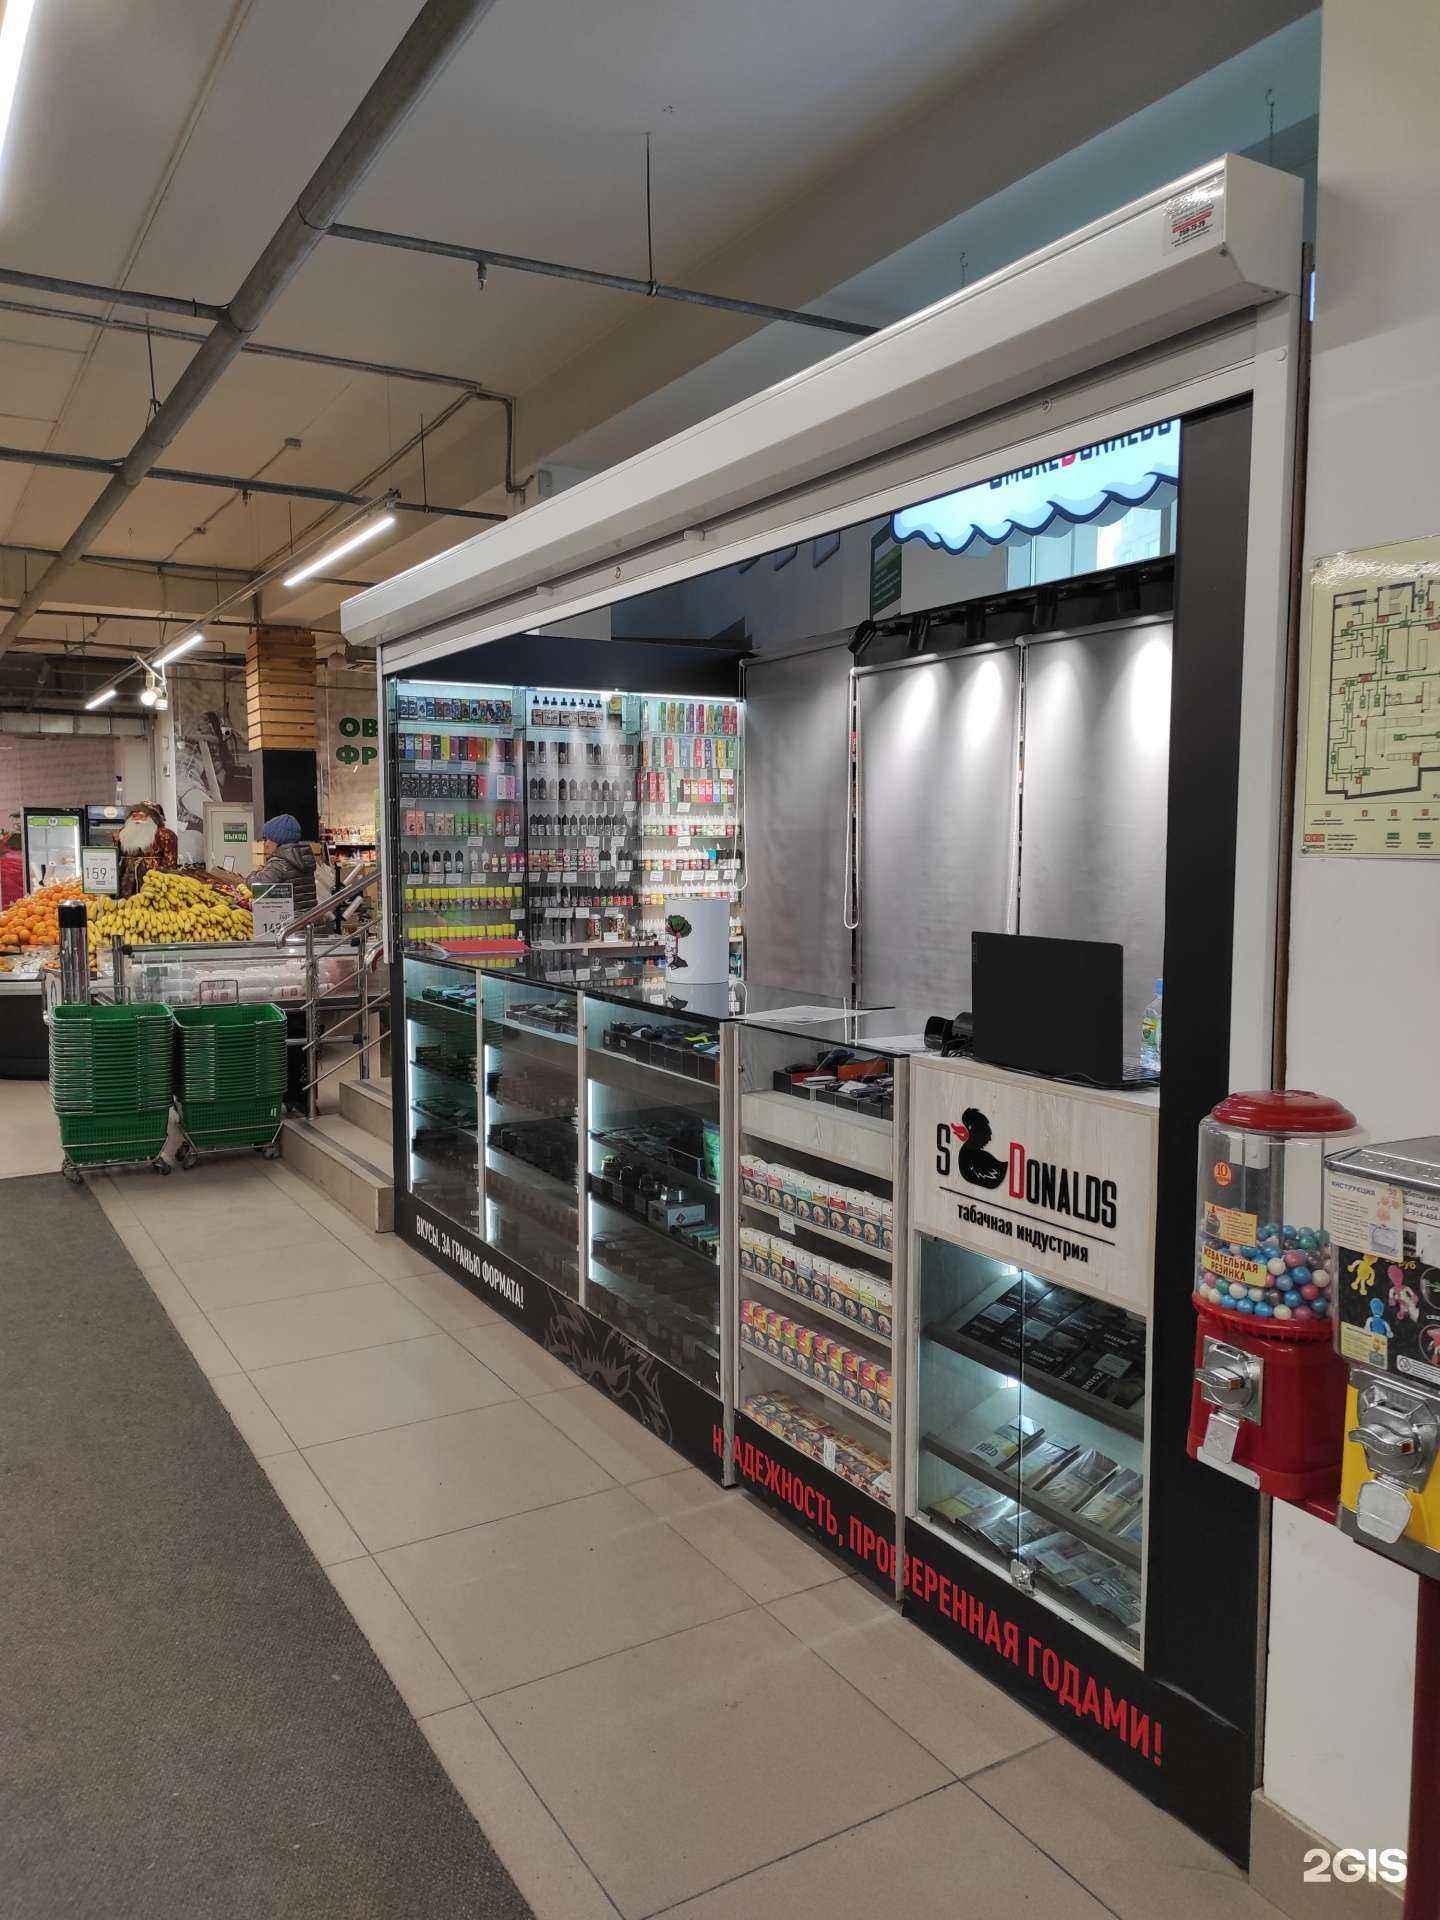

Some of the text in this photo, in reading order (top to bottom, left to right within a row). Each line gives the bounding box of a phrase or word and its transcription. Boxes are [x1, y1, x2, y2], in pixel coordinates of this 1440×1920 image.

[224, 832, 247, 841] ВЫХОД
[416, 1215, 524, 1309] ВКУСЫ, ЗА ГРАНЬЮ ФОРМАТА!
[957, 1203, 1089, 1263] табачная индустрия
[1210, 1261, 1246, 1281] РЕЗИНКА
[848, 1513, 1020, 1666] ПРОВЕРЕННАЯ
[1027, 1636, 1162, 1768] ГОДАМИ!
